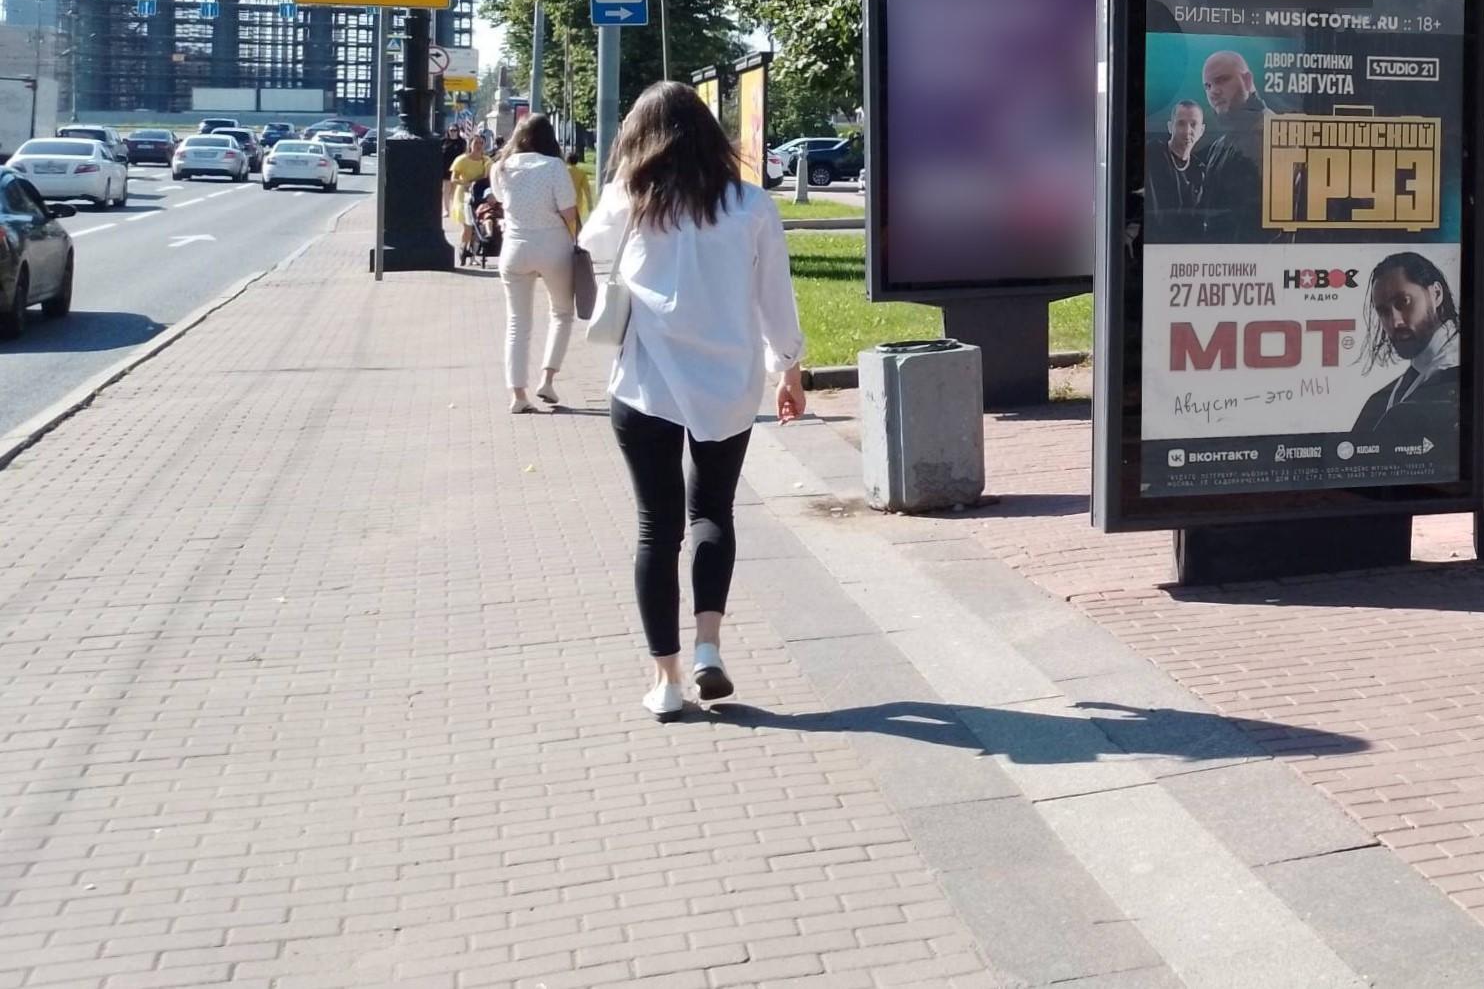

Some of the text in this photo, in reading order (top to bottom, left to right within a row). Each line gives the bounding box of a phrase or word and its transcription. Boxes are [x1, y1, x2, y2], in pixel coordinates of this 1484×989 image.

[1174, 6, 1245, 24] БИЛЕТЫ
[1265, 11, 1399, 30] MUSICTOTHE.RU
[1417, 16, 1441, 31] 18+
[1264, 52, 1353, 69] ДВОР ГОСТИНКИ
[1372, 62, 1434, 76] STUDIO 21
[1264, 72, 1354, 95] 25 АВГУСТА
[1271, 121, 1435, 148] КАСПИЙСКИЙ
[1271, 147, 1434, 221] ГРУЗ
[1170, 262, 1257, 278] ДВОР ГОСТИНКИ
[1169, 282, 1276, 307] 27 АВГУСТА
[1304, 293, 1339, 302] РАДИО
[1169, 318, 1356, 372] МОТ
[1174, 393, 1238, 423] Август
[1265, 390, 1294, 404] это
